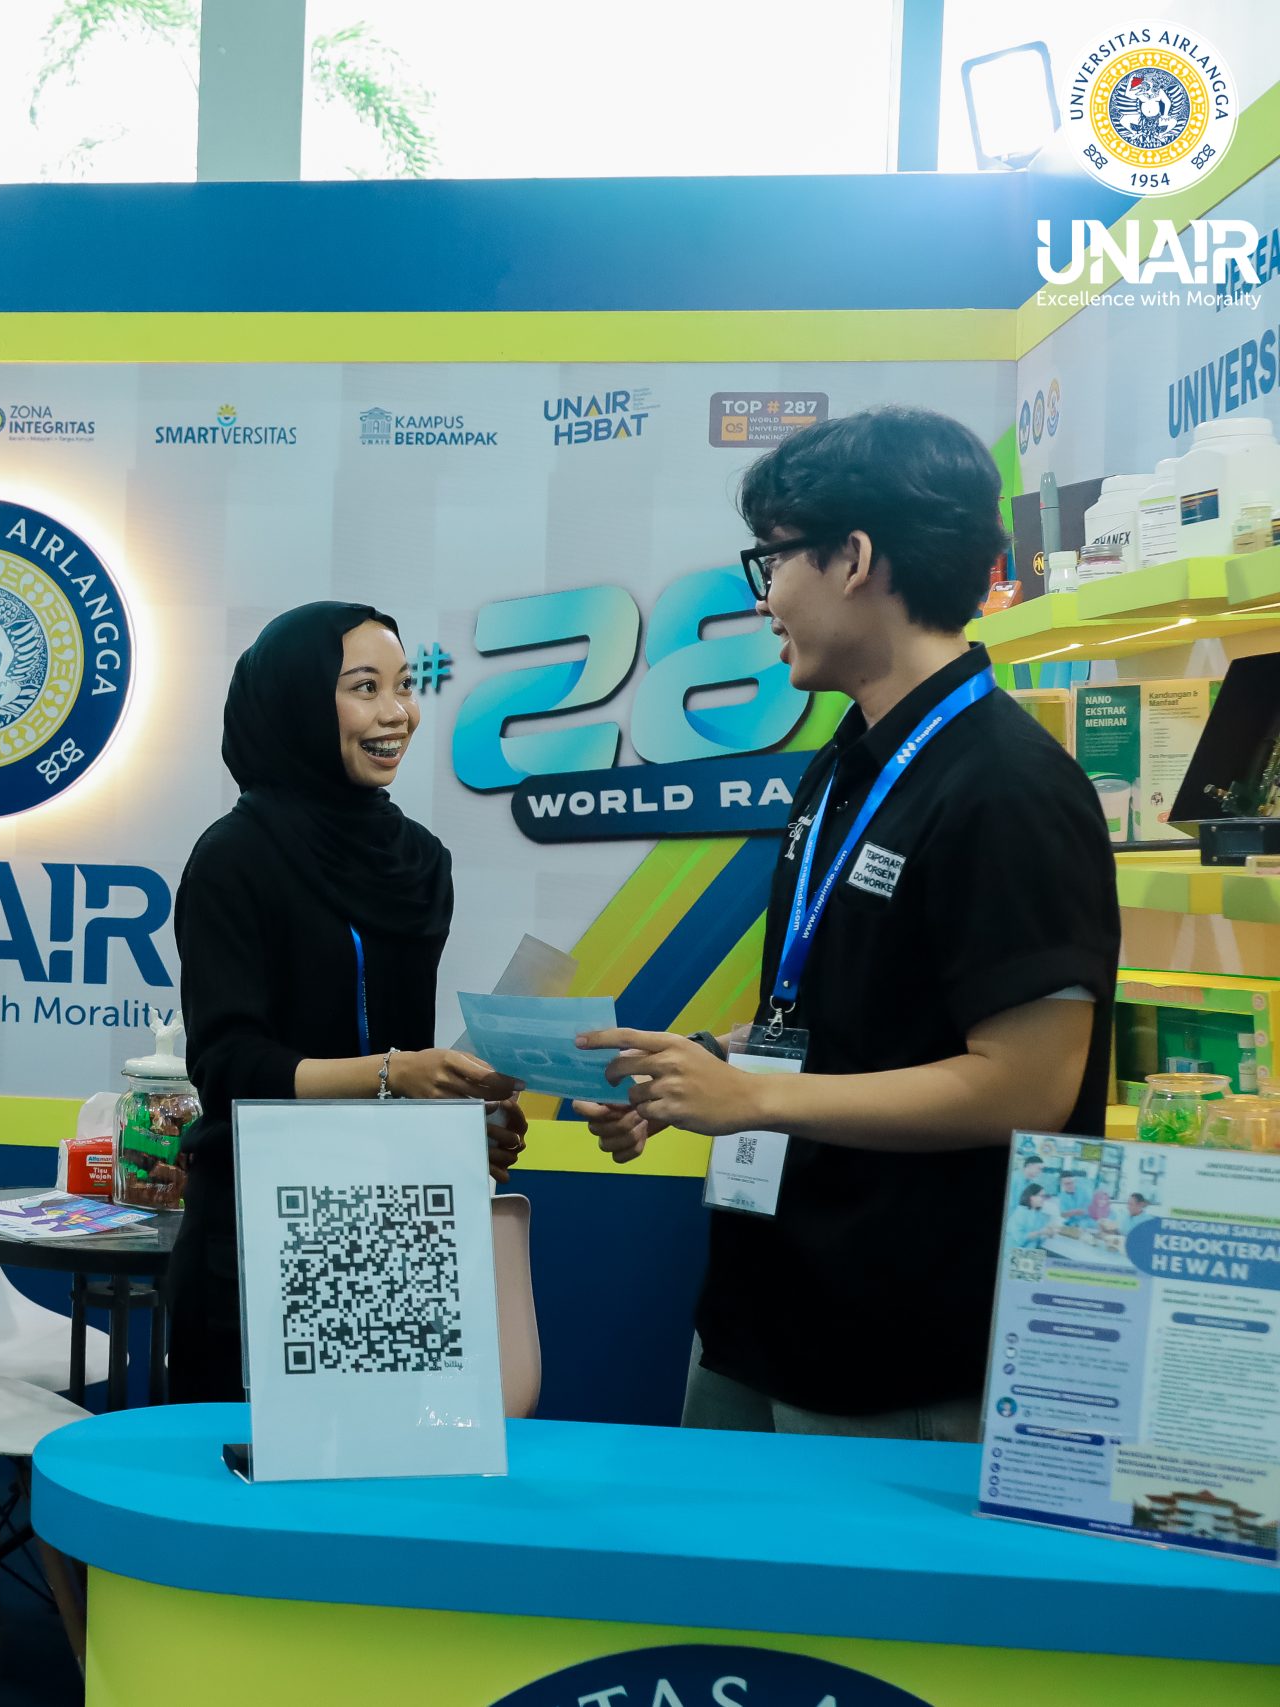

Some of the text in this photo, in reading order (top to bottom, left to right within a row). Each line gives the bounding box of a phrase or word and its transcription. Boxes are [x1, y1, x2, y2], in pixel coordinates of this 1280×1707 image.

[1169, 325, 1280, 438] UNIVERS
[10, 405, 53, 419] ZONA
[543, 390, 631, 421] UNAIR
[721, 400, 763, 414] TOP
[784, 401, 818, 414] 287
[9, 421, 95, 434] INTEGRITAS
[395, 416, 464, 429] KAMPUS
[725, 423, 744, 433] QS
[155, 426, 297, 445] SMARTVERSITAS
[394, 432, 498, 445] BERDAMPAK
[6, 517, 121, 697] AIRLANGGA
[1085, 696, 1112, 705] NANO
[1085, 706, 1126, 716] EKSTRAK
[914, 715, 943, 744] Napindo
[1085, 718, 1127, 728] MENIRAN
[527, 777, 794, 819] WORLD RA
[801, 850, 848, 939] www.napindo.com
[33, 995, 174, 1029] Morality
[1151, 1255, 1250, 1280] HEWAN
